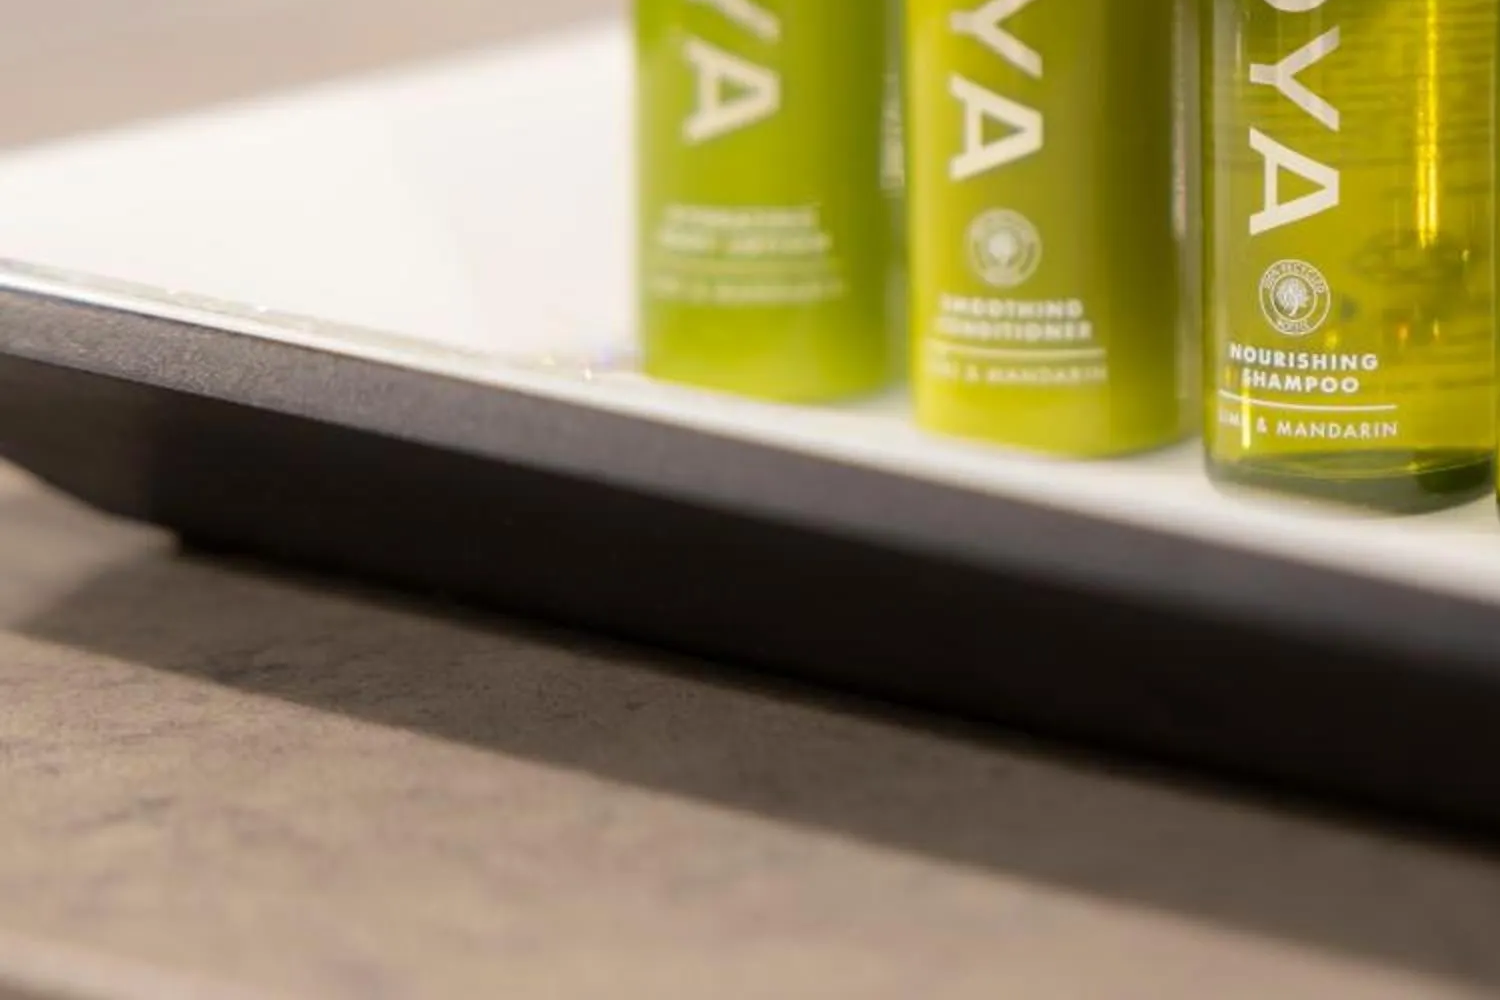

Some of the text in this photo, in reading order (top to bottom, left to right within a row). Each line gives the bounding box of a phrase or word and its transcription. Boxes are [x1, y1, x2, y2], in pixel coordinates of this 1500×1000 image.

[1229, 343, 1379, 370] NOURISHING
[1241, 370, 1360, 393] SHAMPOO
[1256, 417, 1268, 434] &
[1276, 420, 1399, 439] MANDARIN
